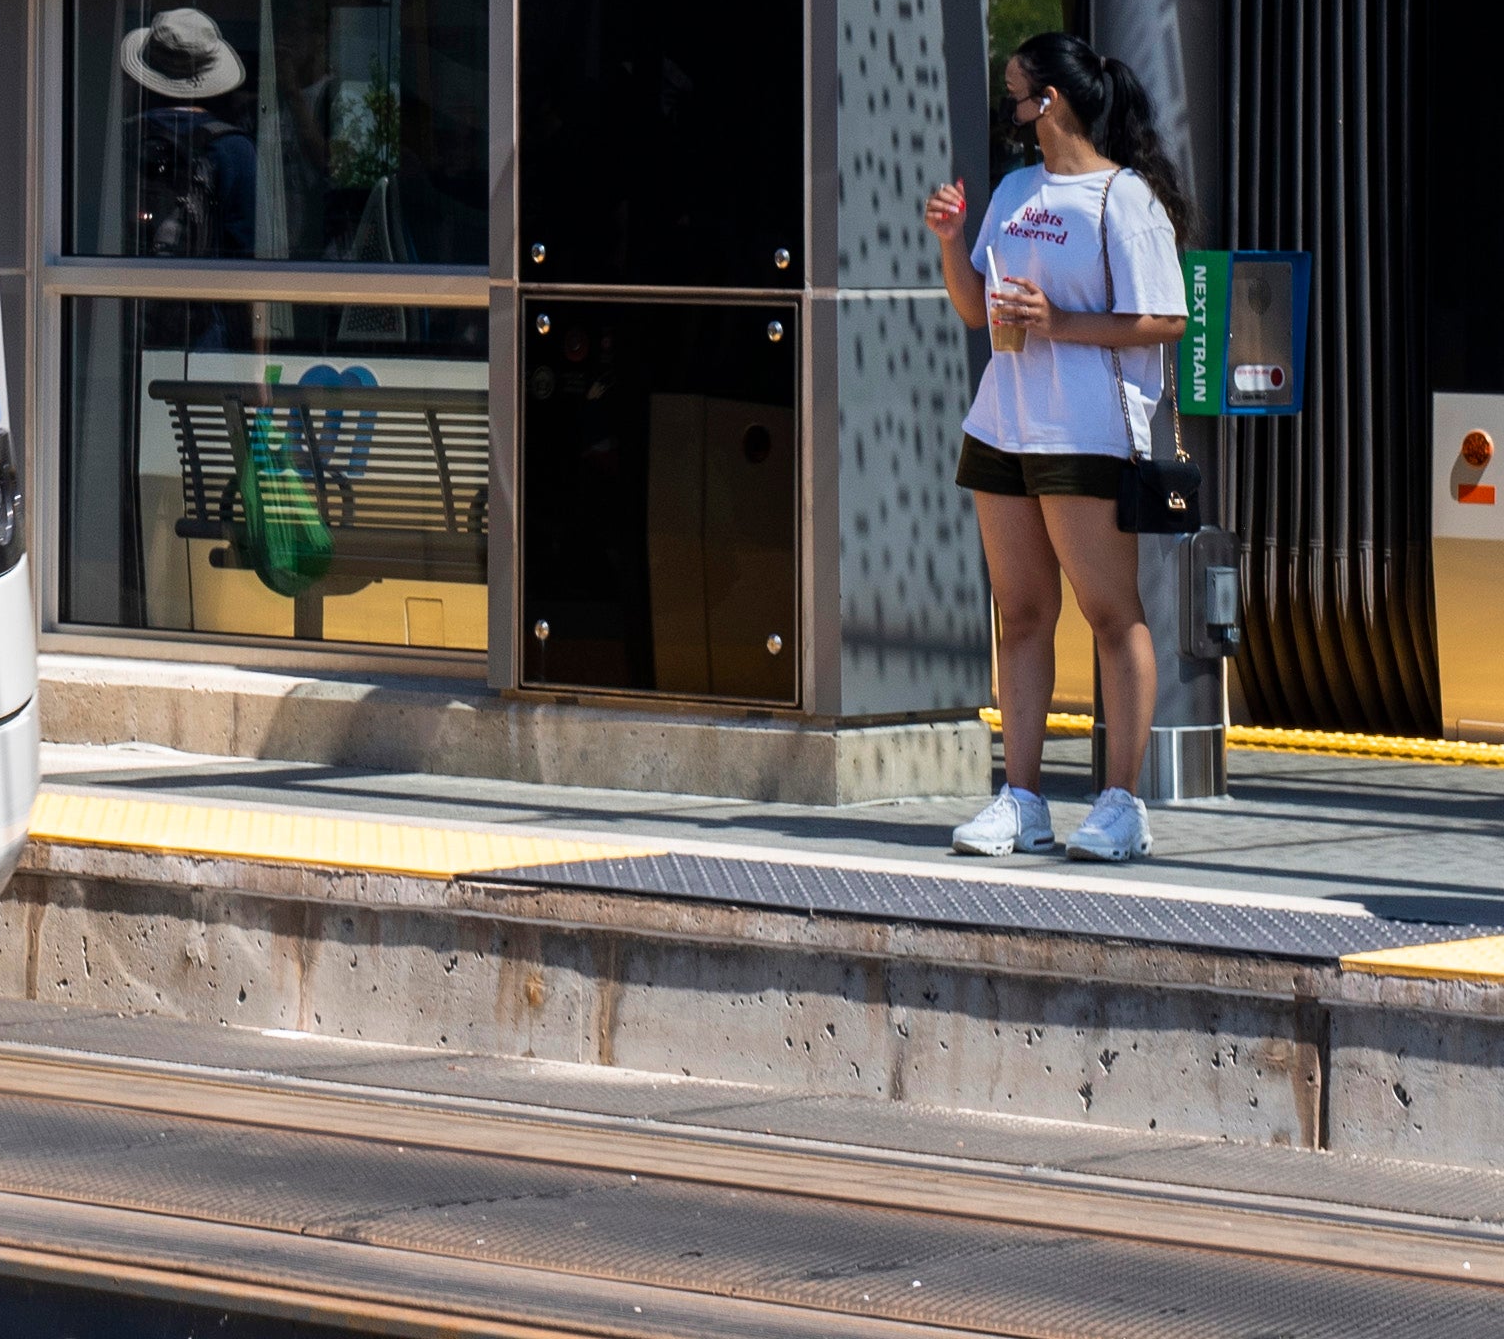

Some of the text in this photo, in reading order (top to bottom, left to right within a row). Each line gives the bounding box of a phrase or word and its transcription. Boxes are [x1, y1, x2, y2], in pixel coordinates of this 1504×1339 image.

[1022, 206, 1063, 227] Rights
[1006, 222, 1068, 246] Reserved
[1193, 265, 1206, 402] NEXT TRAIN
